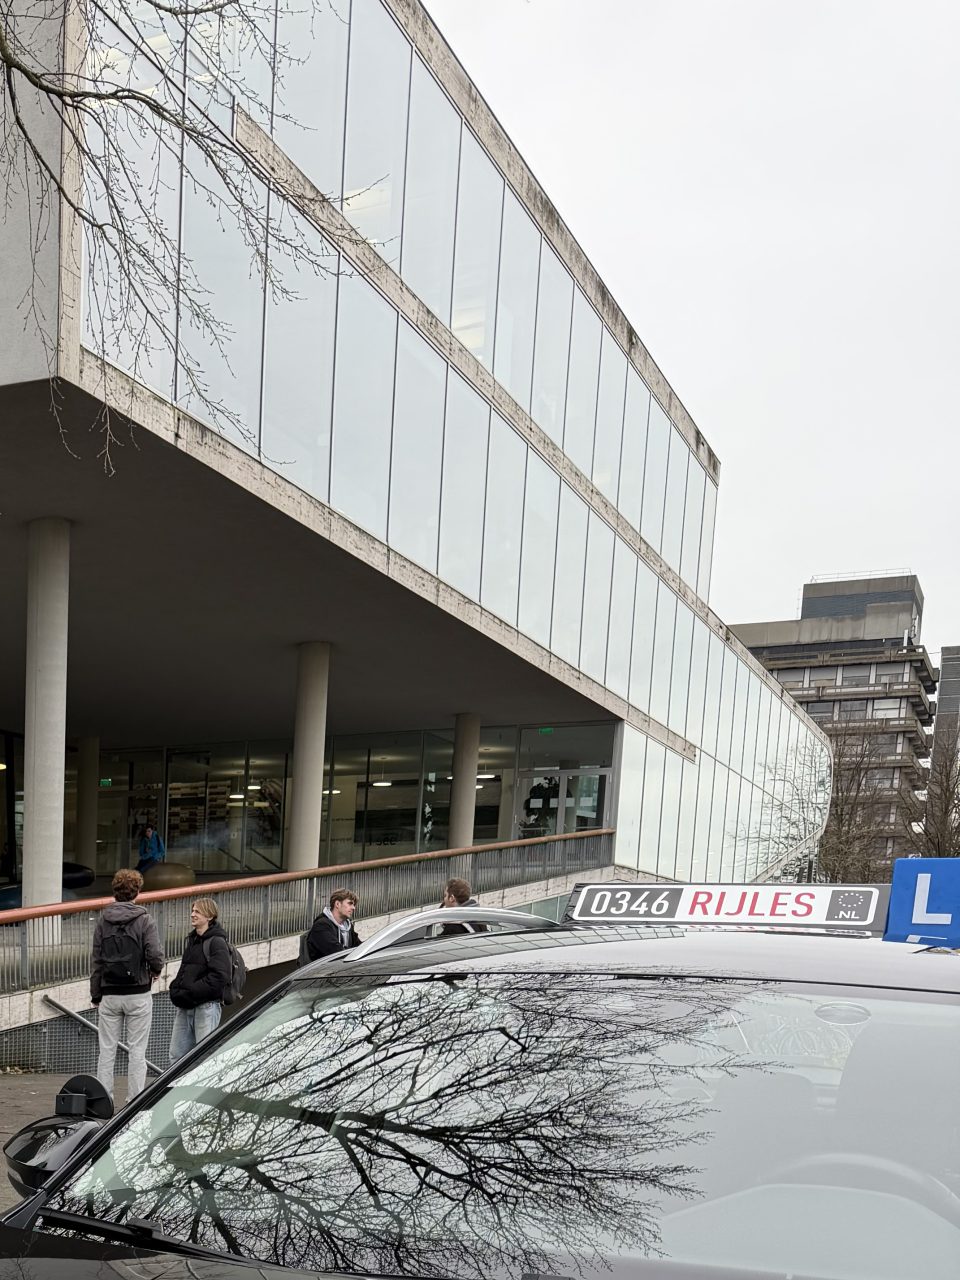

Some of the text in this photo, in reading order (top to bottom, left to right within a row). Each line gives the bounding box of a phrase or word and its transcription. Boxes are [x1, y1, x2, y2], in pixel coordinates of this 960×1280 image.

[589, 890, 670, 916] 0346
[687, 891, 816, 918] RIJLES
[911, 873, 952, 925] L
